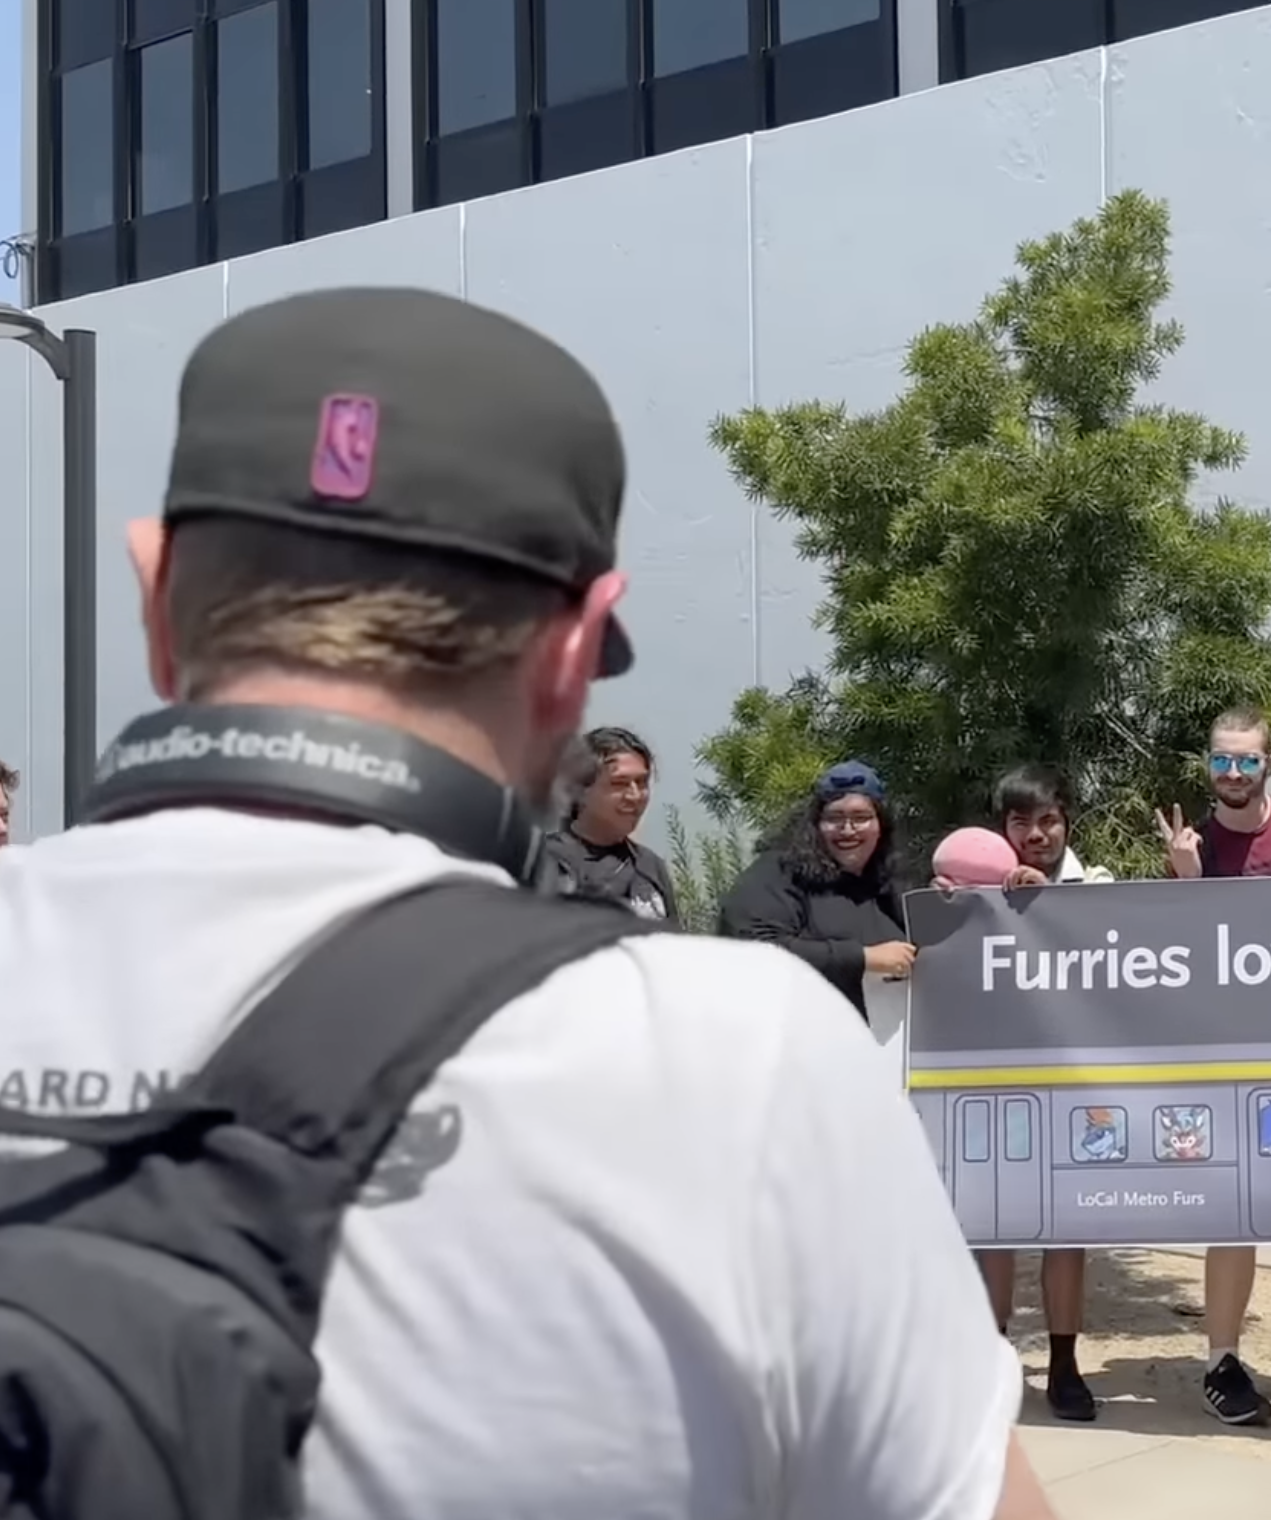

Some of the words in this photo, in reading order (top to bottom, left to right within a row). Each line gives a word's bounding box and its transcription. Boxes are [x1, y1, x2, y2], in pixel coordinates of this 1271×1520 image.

[982, 929, 1191, 992] Furries
[1077, 1190, 1118, 1207] LoCal
[1123, 1191, 1168, 1206] Metro
[1173, 1190, 1205, 1206] Furs
